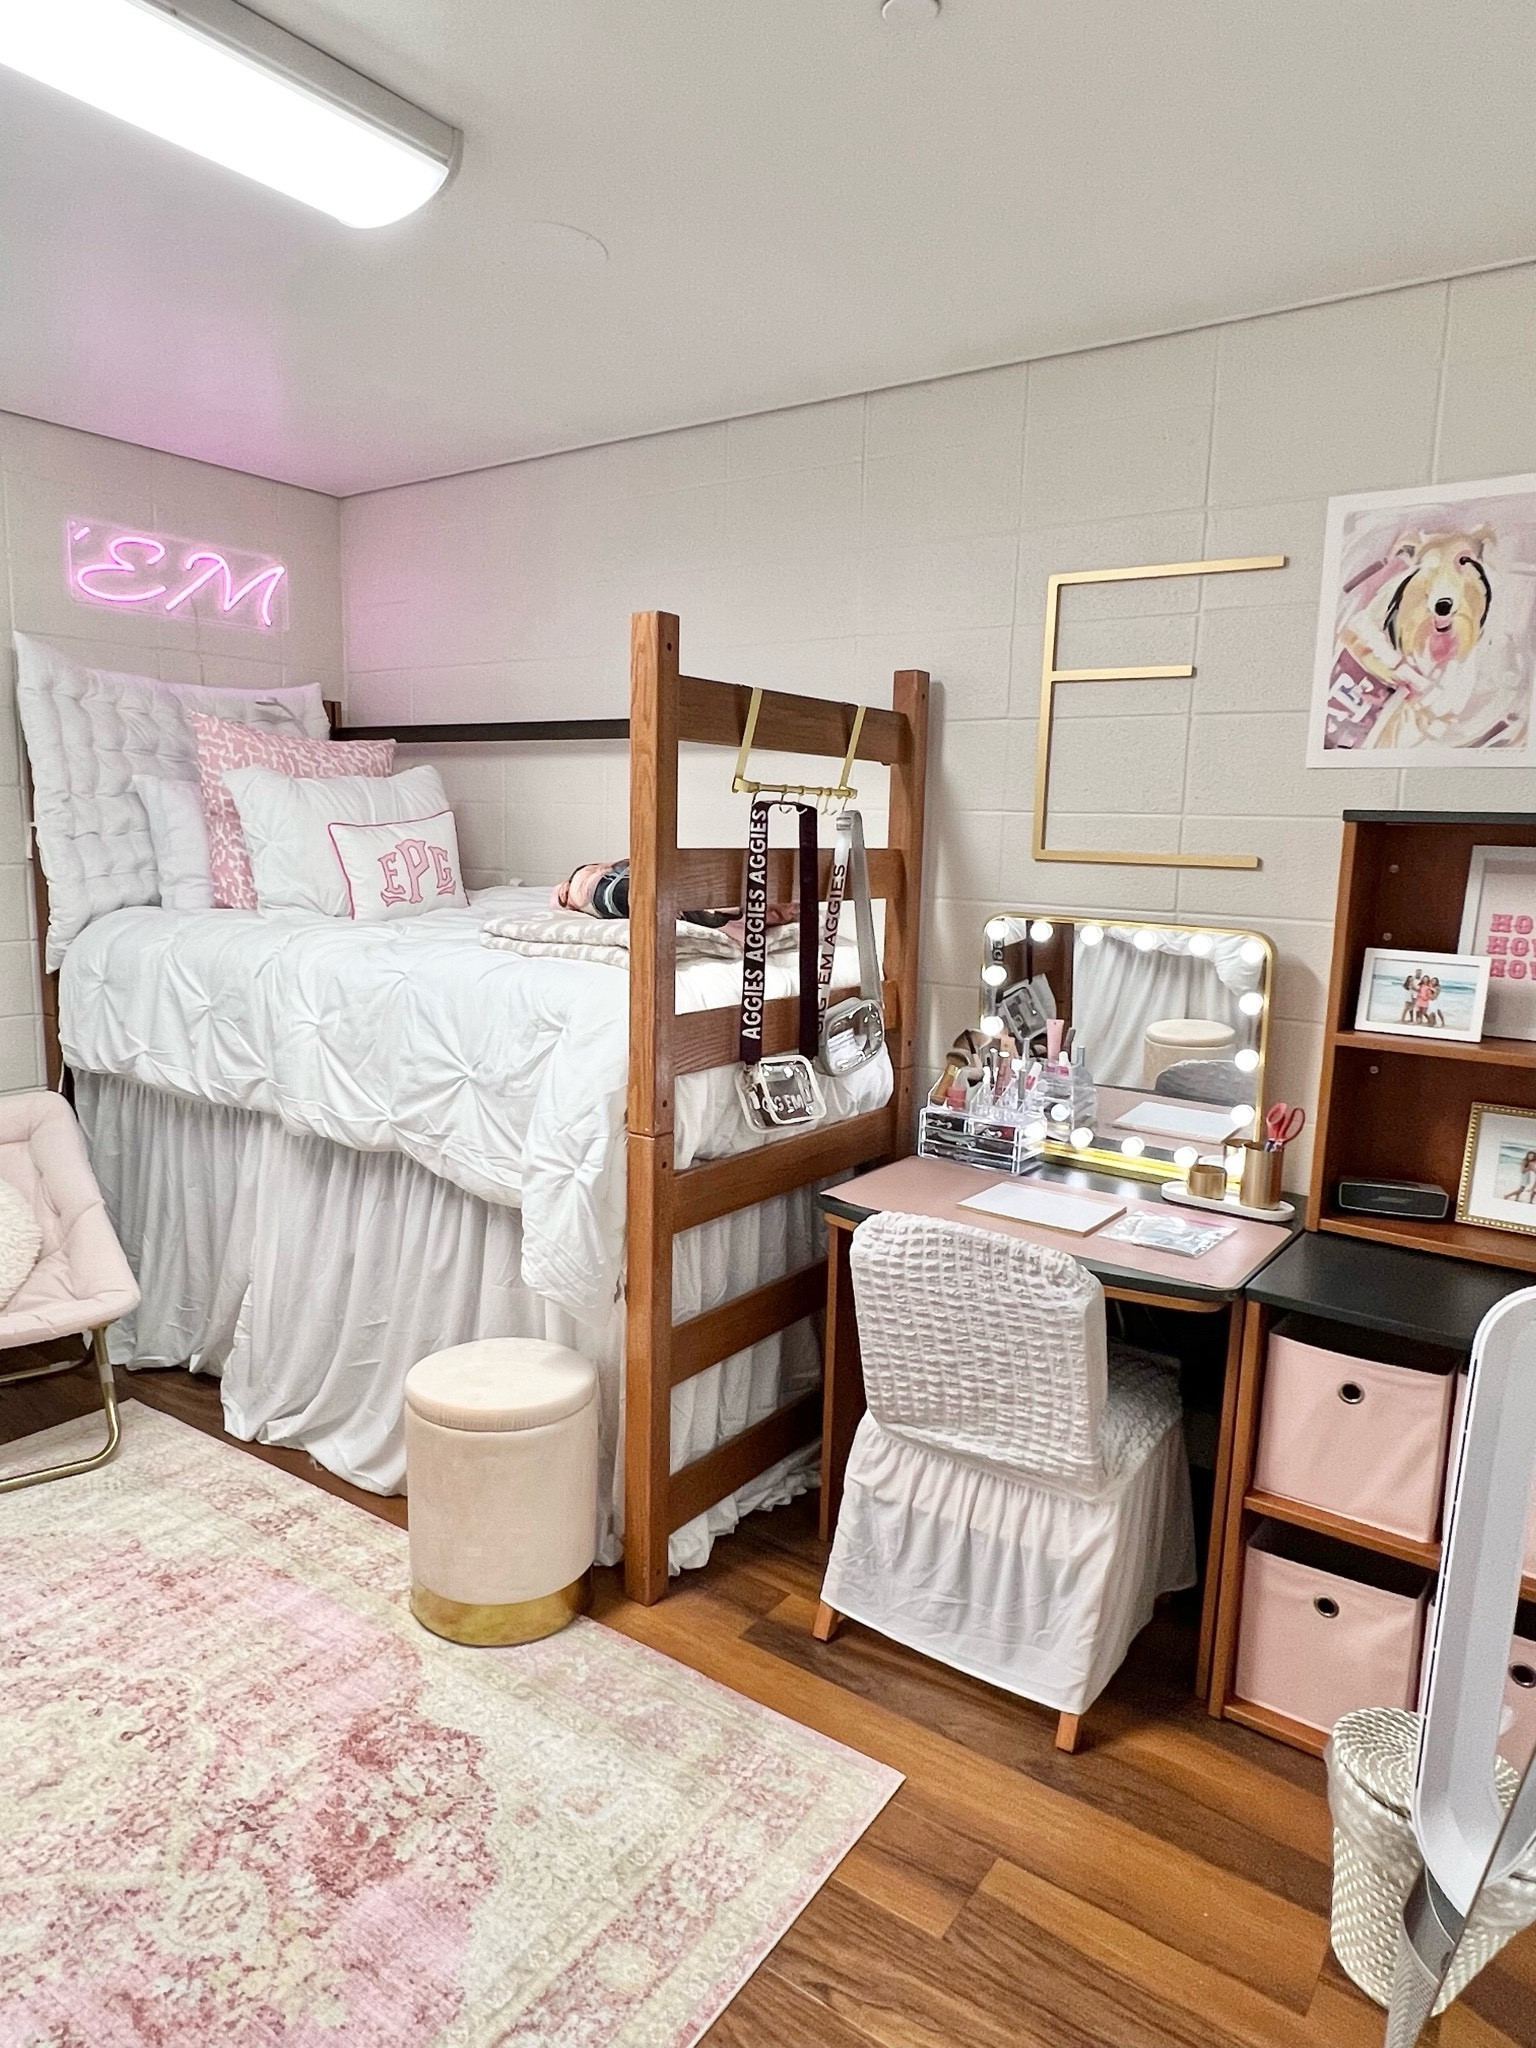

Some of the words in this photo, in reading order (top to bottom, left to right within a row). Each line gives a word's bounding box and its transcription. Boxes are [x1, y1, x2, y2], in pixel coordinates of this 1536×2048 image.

[748, 809, 767, 885] AGGIES
[746, 889, 766, 962] AGGIES
[824, 864, 846, 946] AGGIES
[1487, 936, 1536, 958] HO
[1490, 959, 1536, 980] HO
[742, 968, 764, 1040] AGGIES
